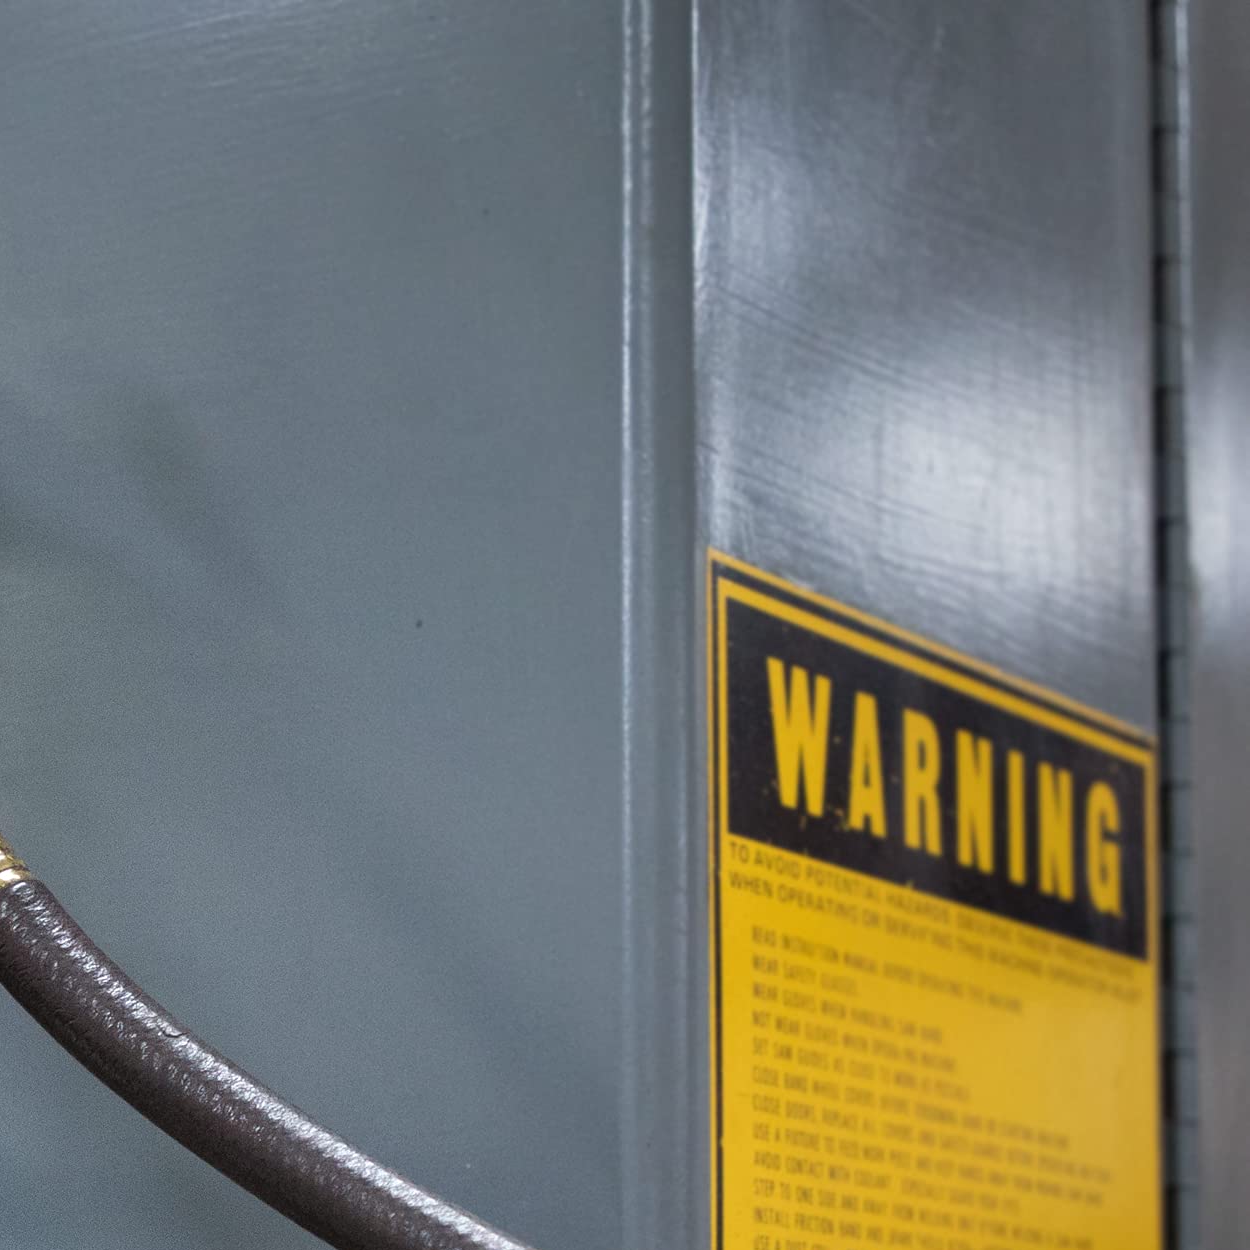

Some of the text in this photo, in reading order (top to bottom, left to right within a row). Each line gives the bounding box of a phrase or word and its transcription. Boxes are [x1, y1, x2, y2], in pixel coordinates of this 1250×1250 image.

[767, 656, 1122, 917] WARNING
[729, 841, 749, 864] TO
[752, 849, 801, 879] AVOID
[729, 869, 773, 899] WHEN
[777, 882, 857, 923] OPERATING
[753, 1206, 790, 1227] INSTALL
